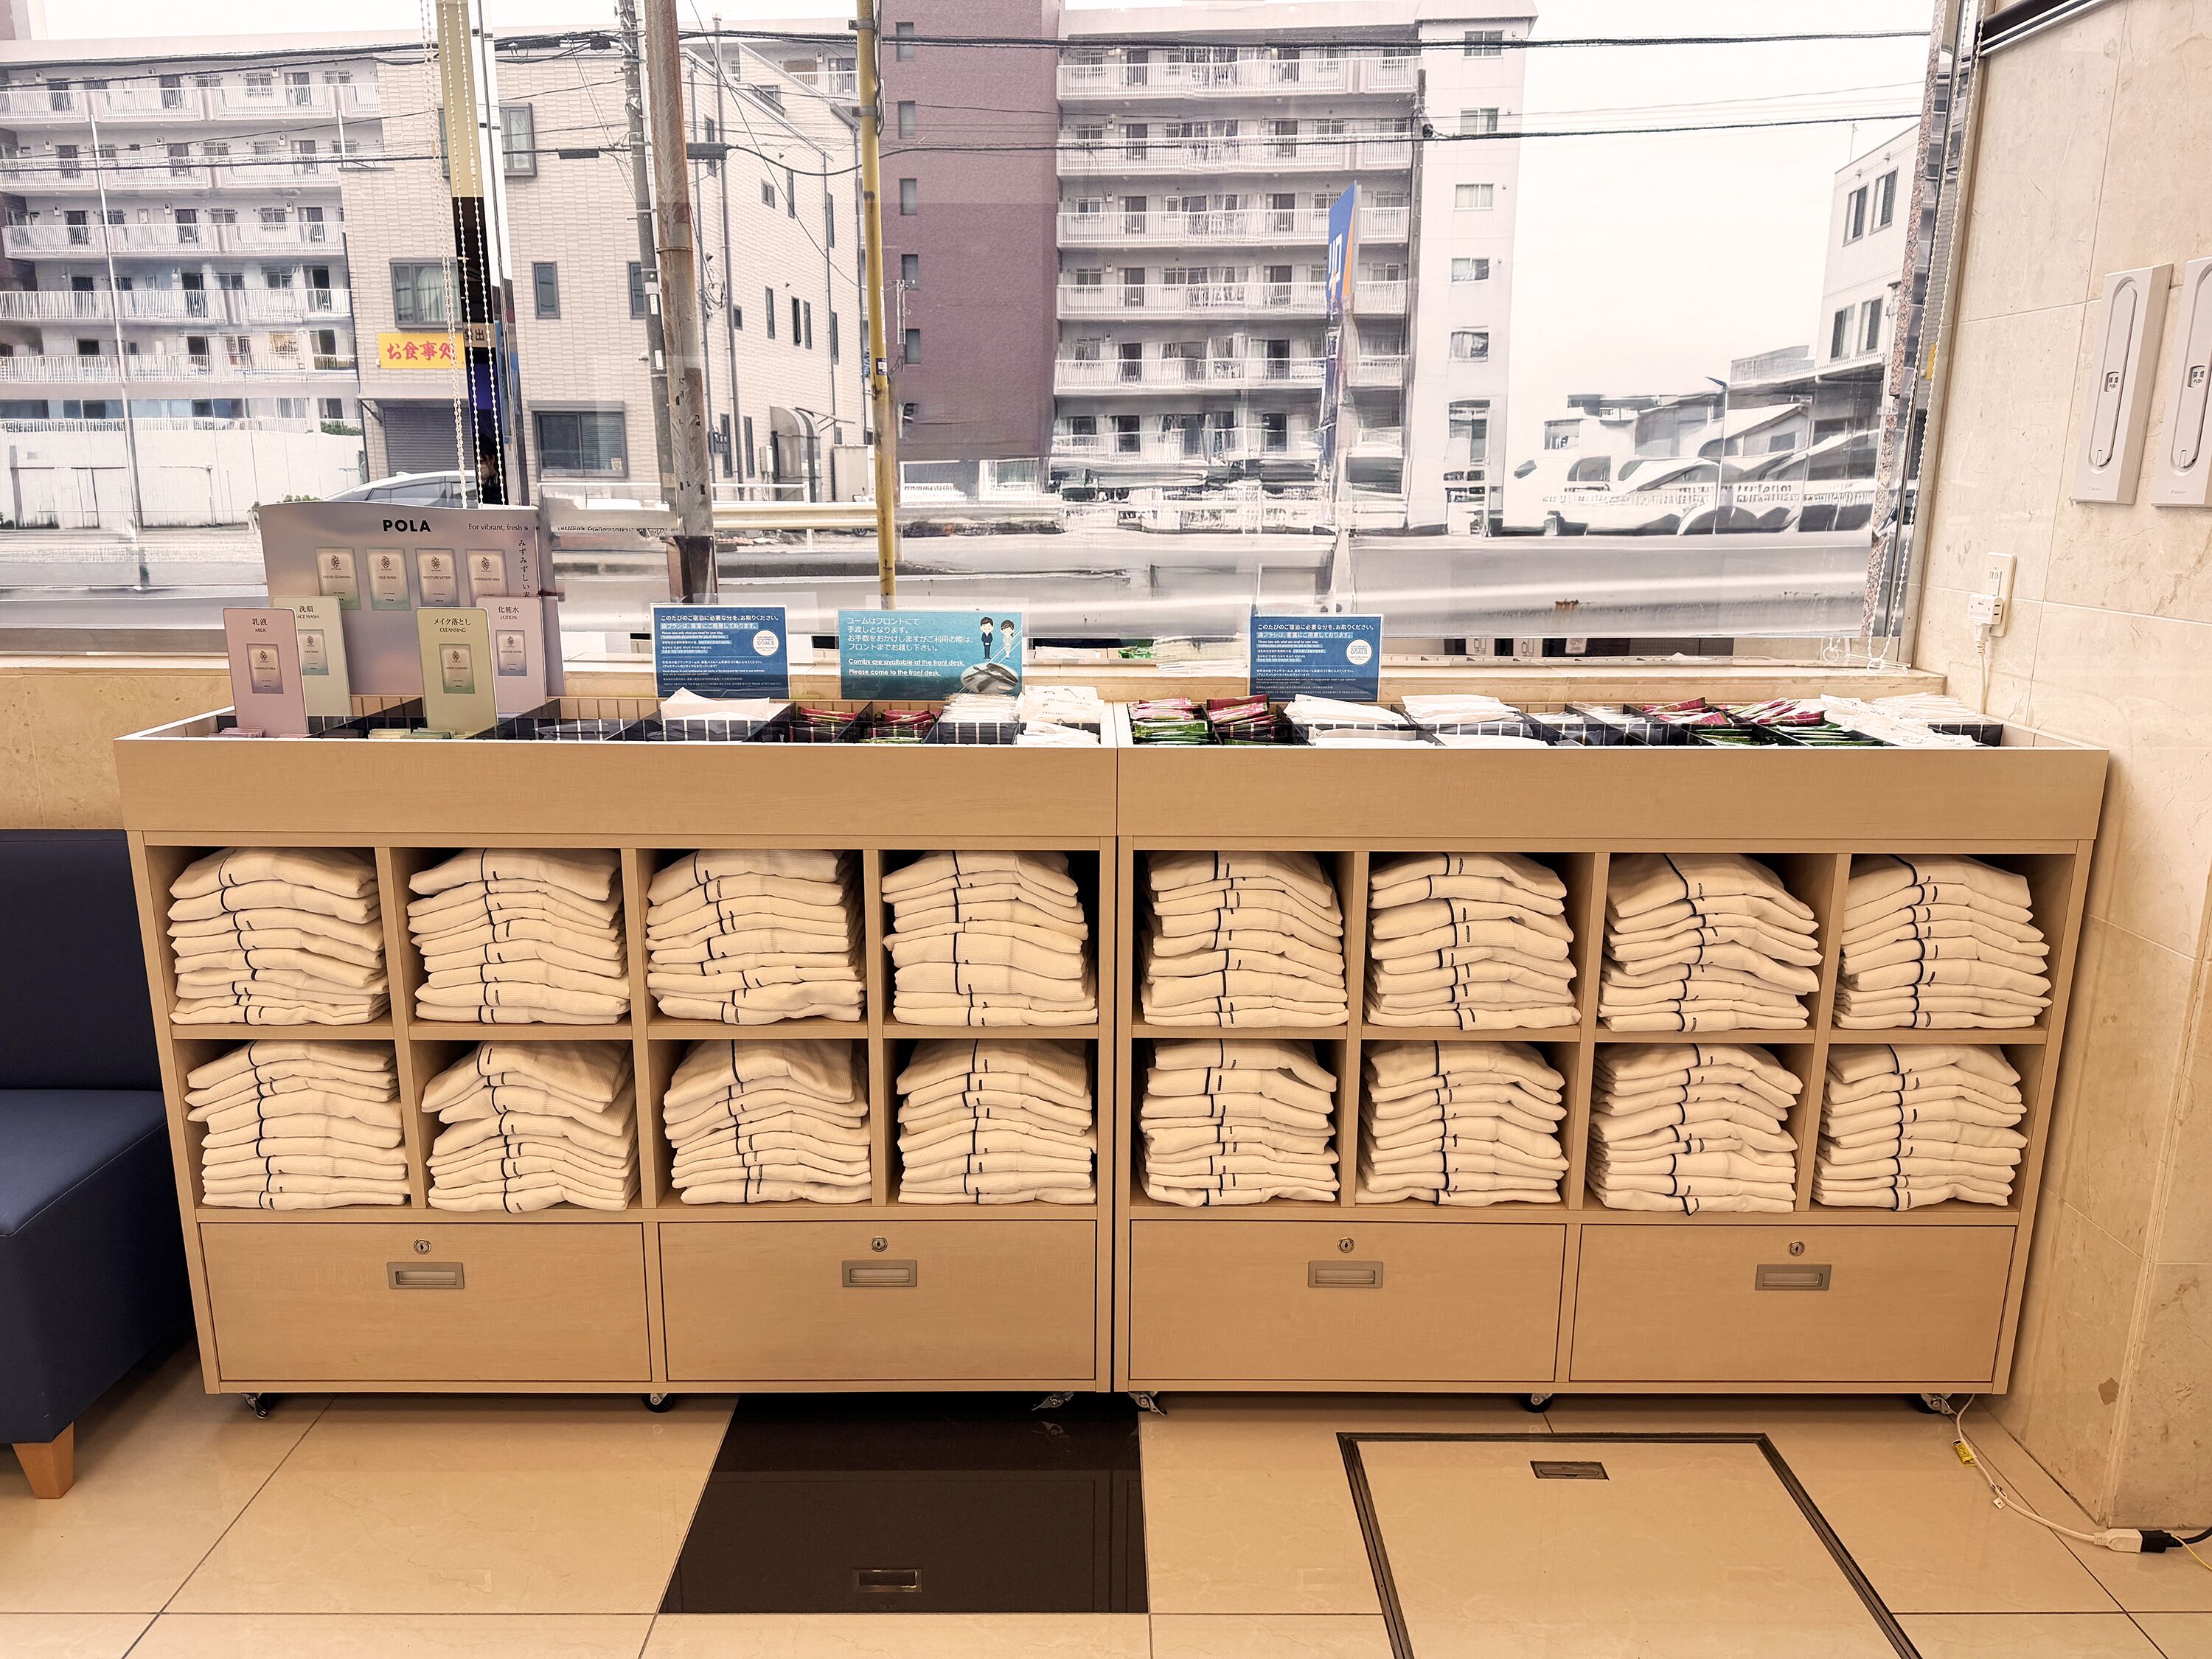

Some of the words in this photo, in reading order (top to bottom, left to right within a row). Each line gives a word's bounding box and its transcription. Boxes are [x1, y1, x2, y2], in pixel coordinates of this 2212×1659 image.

[383, 519, 431, 532] POLA
[847, 617, 919, 625] コームはフロントにて
[847, 626, 908, 634] 手渡しとなります。
[848, 635, 973, 644] お手数をおかけしますがご利用の際は、
